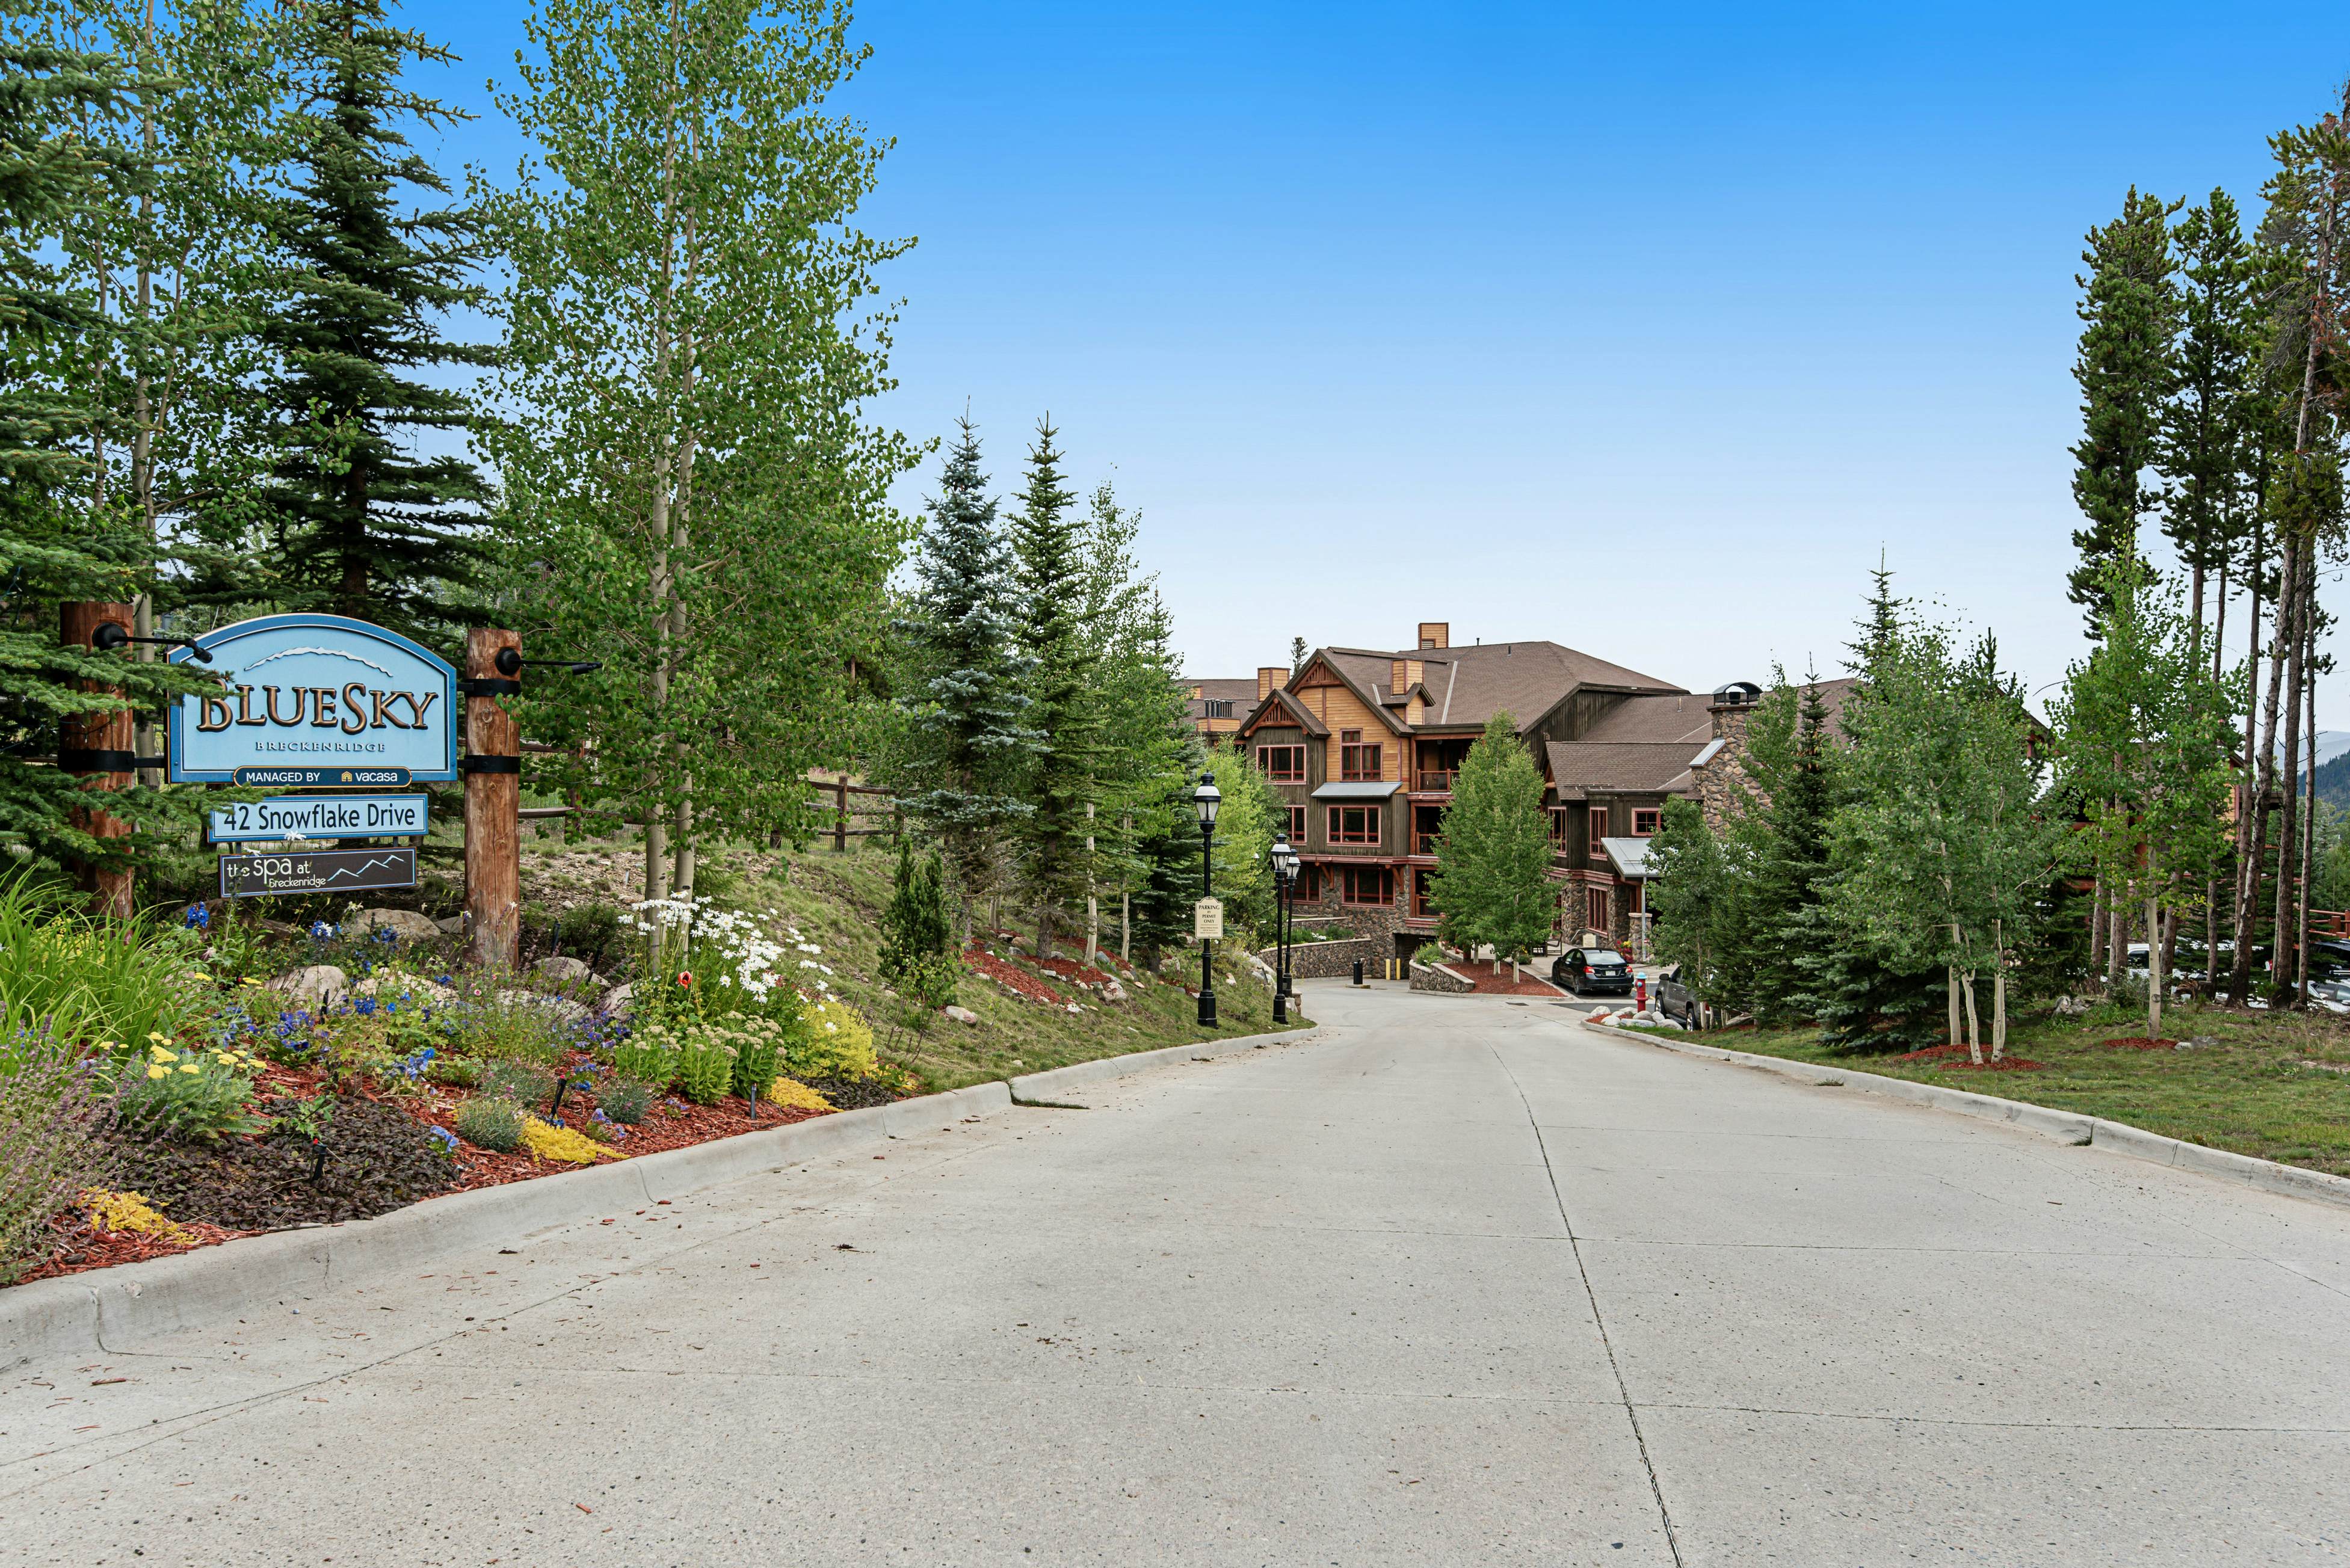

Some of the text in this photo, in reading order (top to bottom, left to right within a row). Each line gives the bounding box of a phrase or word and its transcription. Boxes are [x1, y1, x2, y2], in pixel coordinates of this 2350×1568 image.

[255, 741, 387, 752] BRECKENRIDGE
[246, 772, 398, 782] MANAGED BY vacasa
[224, 803, 416, 831] 42 Snowflake Drive
[253, 858, 292, 885] spa
[297, 861, 310, 874] at
